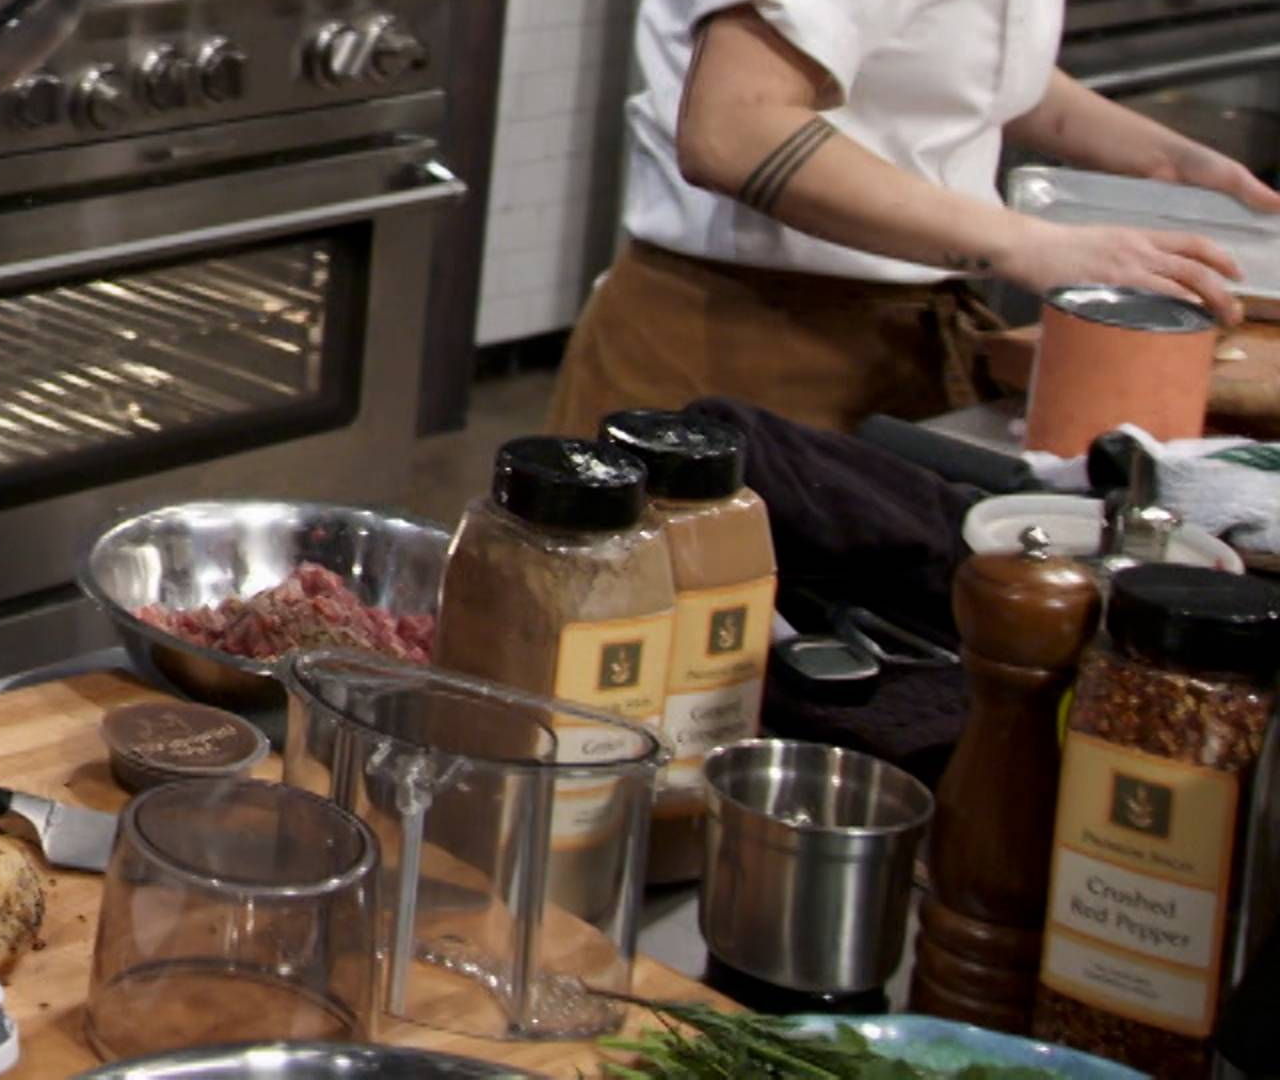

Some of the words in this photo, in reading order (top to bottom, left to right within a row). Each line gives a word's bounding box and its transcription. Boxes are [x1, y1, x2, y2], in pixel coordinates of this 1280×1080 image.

[1086, 874, 1177, 918] Crushed
[1070, 894, 1109, 924] Red
[1115, 911, 1192, 947] Pepper
